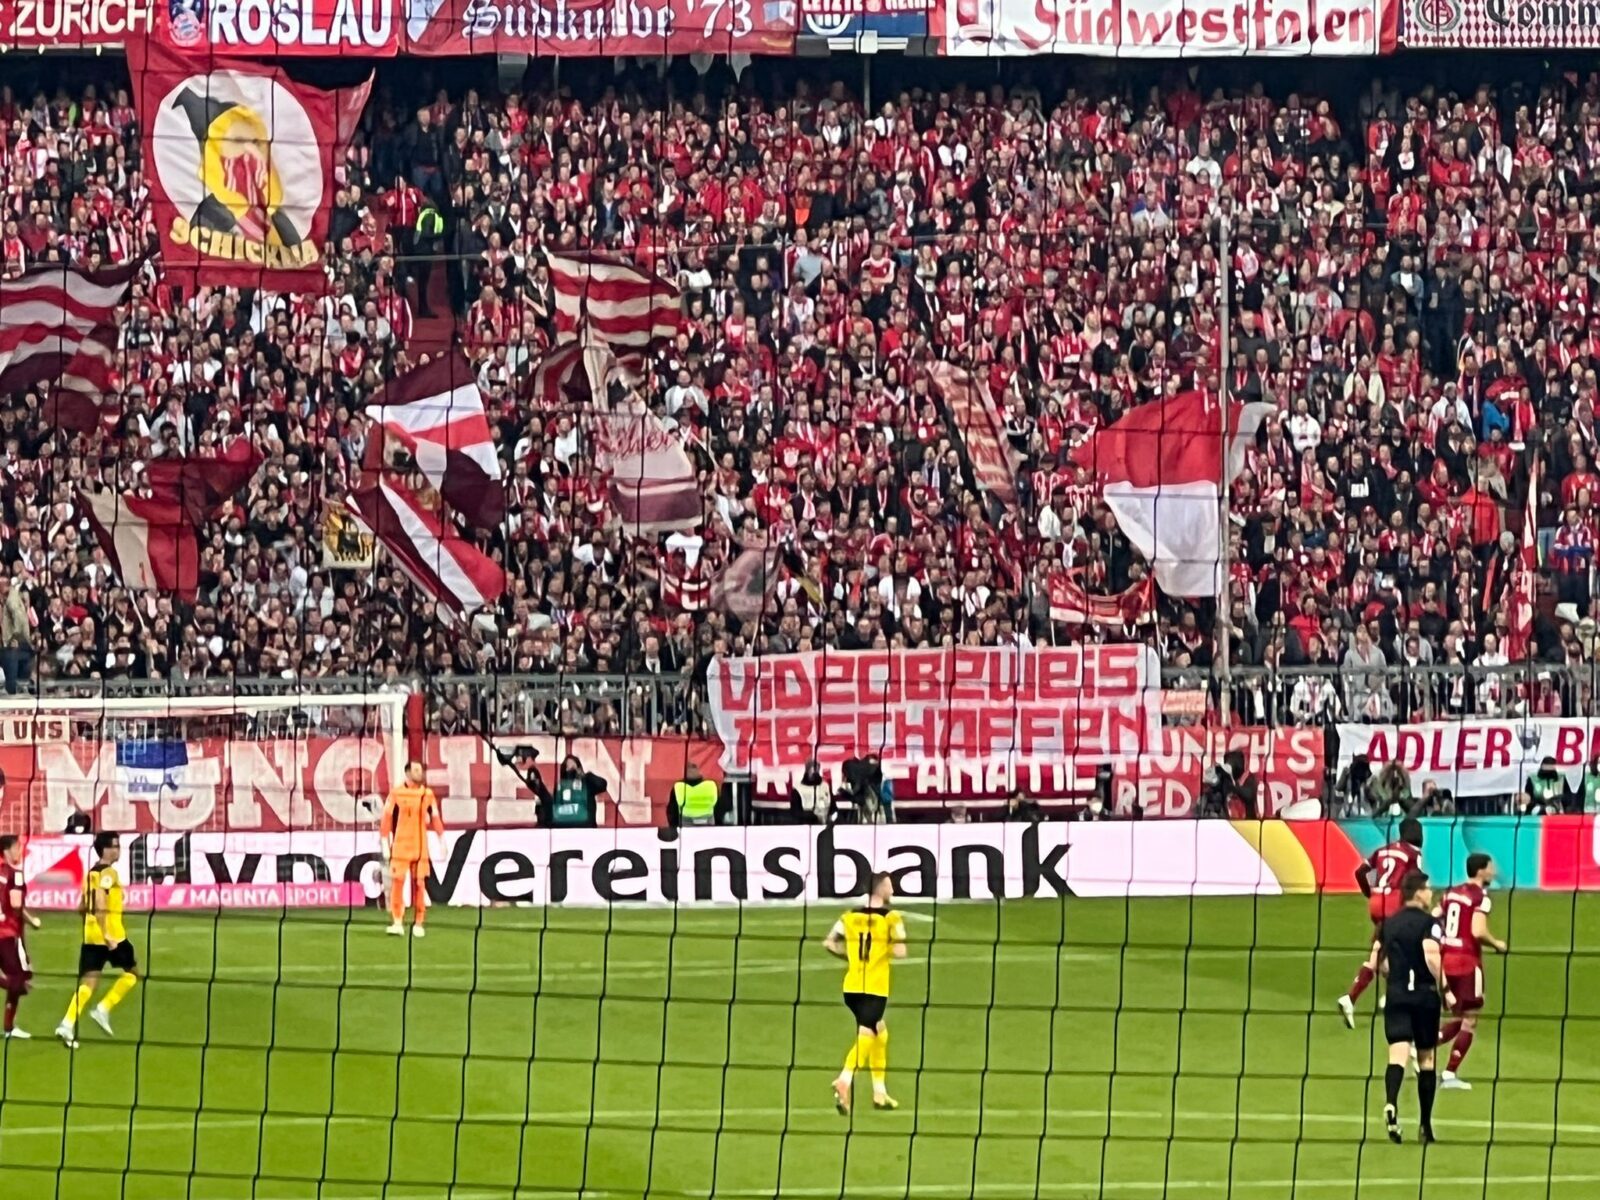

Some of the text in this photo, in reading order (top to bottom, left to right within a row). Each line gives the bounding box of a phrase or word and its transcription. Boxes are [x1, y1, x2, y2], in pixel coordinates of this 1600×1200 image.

[210, 0, 392, 47] ROSLAU
[13, 720, 63, 740] UNS
[1367, 727, 1512, 772] ADLER
[1377, 857, 1397, 890] 2
[189, 888, 279, 905] MAGENTA
[1445, 902, 1461, 938] 8
